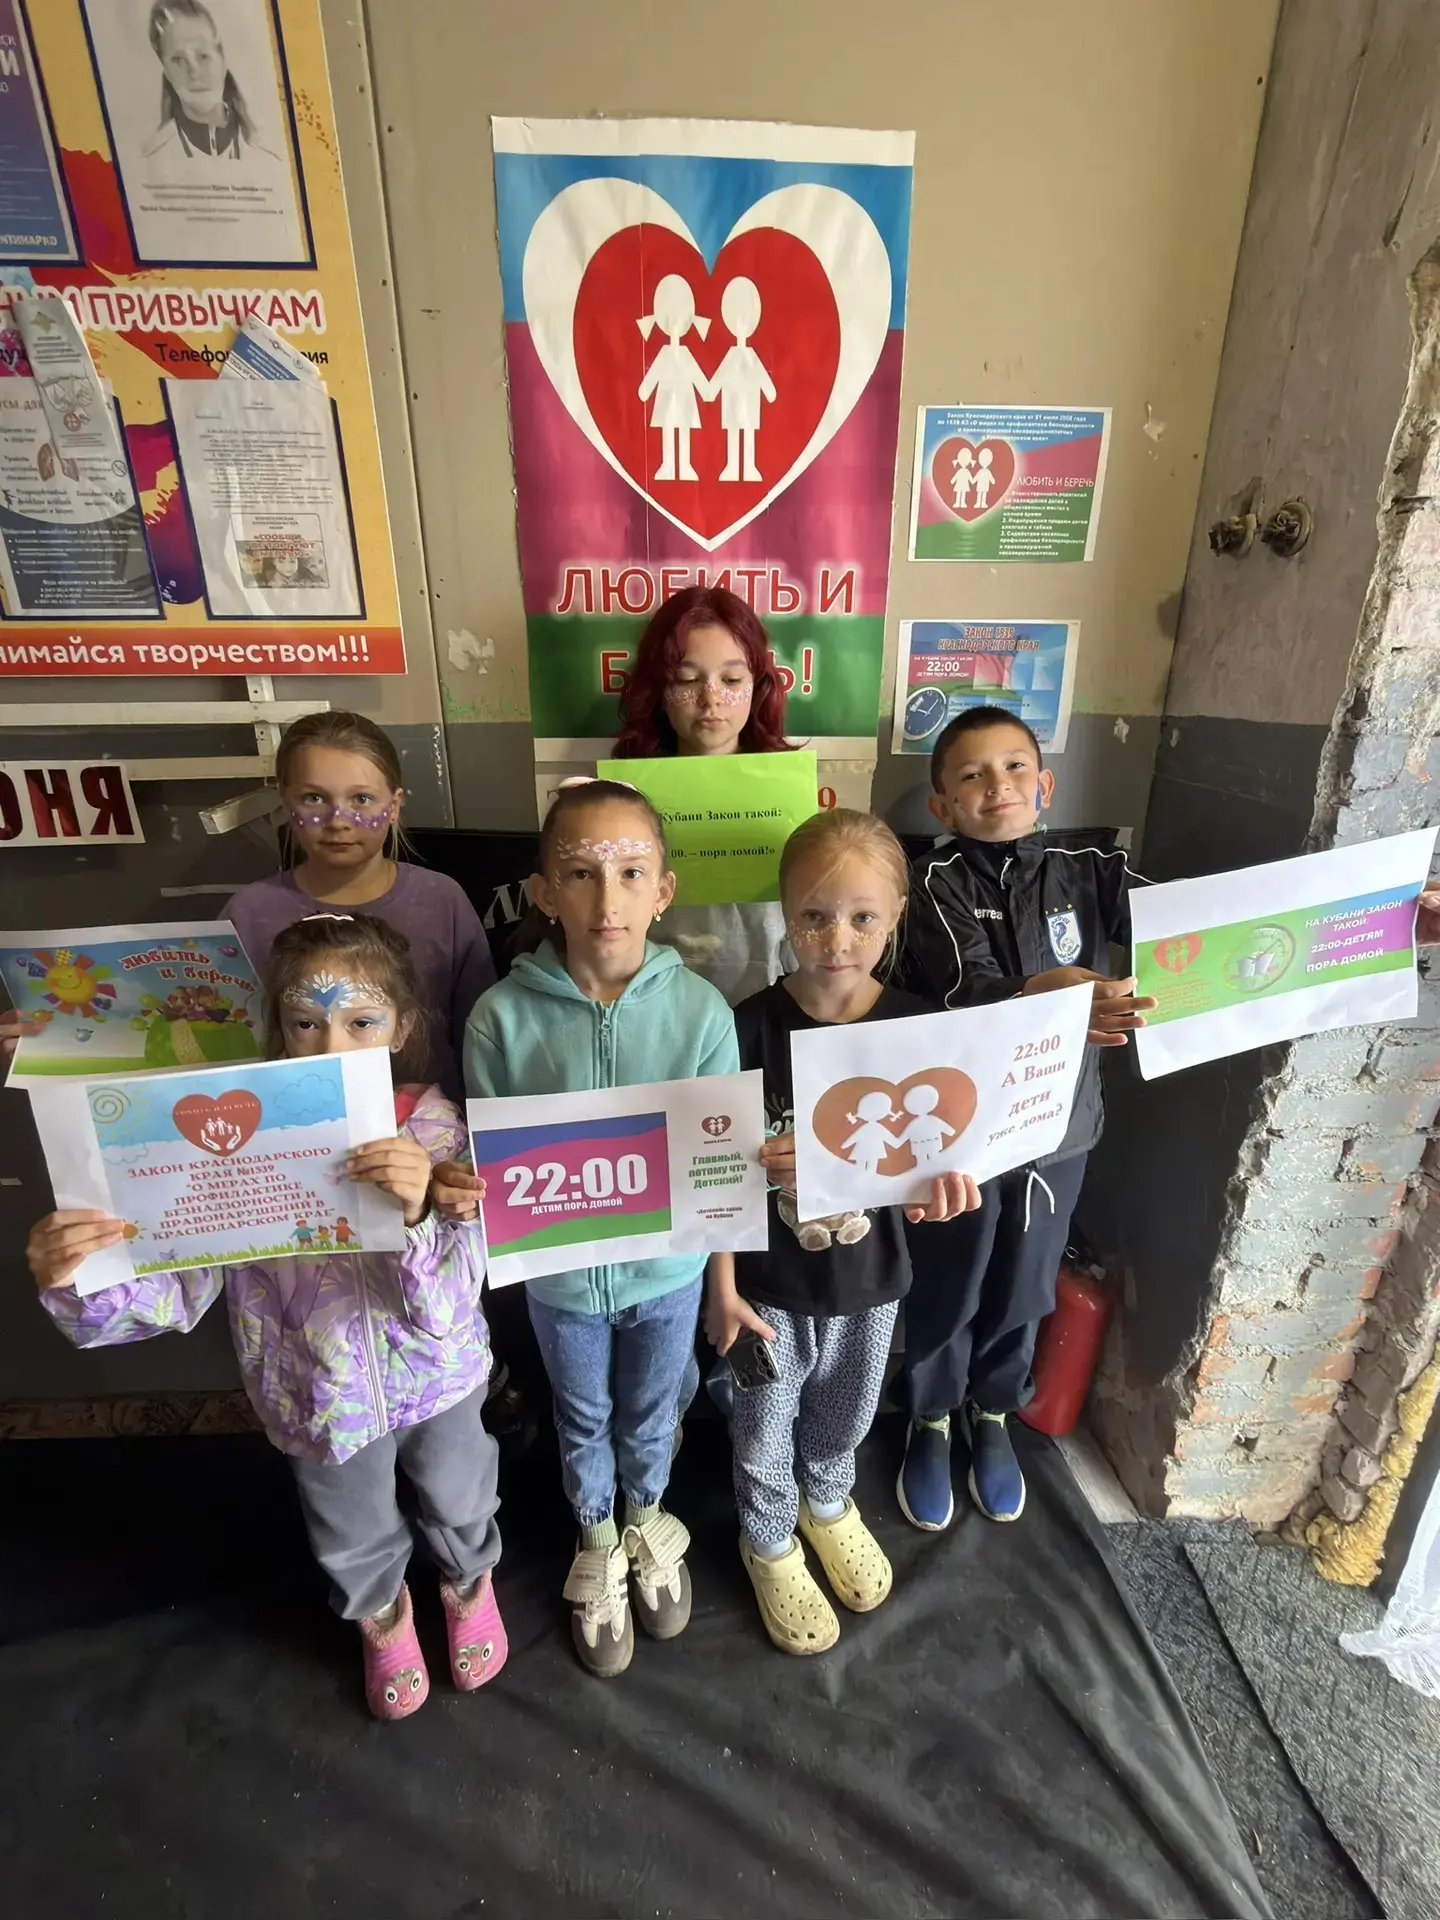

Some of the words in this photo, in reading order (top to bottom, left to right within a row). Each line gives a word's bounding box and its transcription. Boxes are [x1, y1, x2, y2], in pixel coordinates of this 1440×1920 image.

[88, 291, 322, 328] ПРИВЫЧКАМ
[1056, 476, 1062, 486] И
[1064, 478, 1094, 488] БЕРЕЧЬ
[819, 569, 856, 614] И
[938, 639, 1014, 651] КРАСНОДАРСКОГО
[1016, 640, 1040, 650] КРАЯ
[964, 627, 994, 638] ЗАКОН
[132, 636, 370, 669] творчеством!!!
[926, 662, 960, 672] 22:00
[706, 810, 741, 820] Закон
[743, 808, 782, 818] такой:
[699, 849, 727, 859] пора
[730, 846, 776, 858] домой!»
[1305, 920, 1320, 928] НА
[1323, 908, 1366, 925] КУБАНИ
[1366, 900, 1403, 914] ЗАКОН
[1310, 928, 1384, 954] 22:00-ДЕТЯМ
[1306, 958, 1338, 974] ПОРА
[1340, 948, 1384, 966] ДОМОЙ
[1013, 1034, 1061, 1062] 22:00
[1001, 1071, 1017, 1088] А
[1023, 1060, 1066, 1082] Ваши
[1008, 1090, 1052, 1118] дети
[987, 1125, 1016, 1146] уже
[1020, 1102, 1063, 1130] дома?
[128, 1164, 184, 1178] ЗАКОН
[189, 1148, 332, 1170] КРАСНОДАРСКОГО
[190, 1170, 234, 1182] КРАЯ
[688, 1165, 728, 1178] потому
[729, 1164, 748, 1173] что
[174, 1181, 303, 1206] ПРОФИЛАКТИКЕ
[208, 1178, 259, 1190] МЕРАХ
[265, 1174, 286, 1183] ПО
[503, 1154, 648, 1207] 22:00
[694, 1174, 743, 1190] Детский!
[160, 1200, 312, 1229] ПРАВОНАРУШЕНИЙ
[316, 1200, 326, 1208] В
[164, 1193, 300, 1218] БЕЗНАДЗОРНОСТИ
[306, 1190, 316, 1199] И
[531, 1201, 563, 1216] ДЕТЯМ
[564, 1200, 588, 1212] ПОРА
[589, 1196, 623, 1210] ДОМОЙ
[152, 1214, 290, 1241] КРАСНОДАРСКОМ
